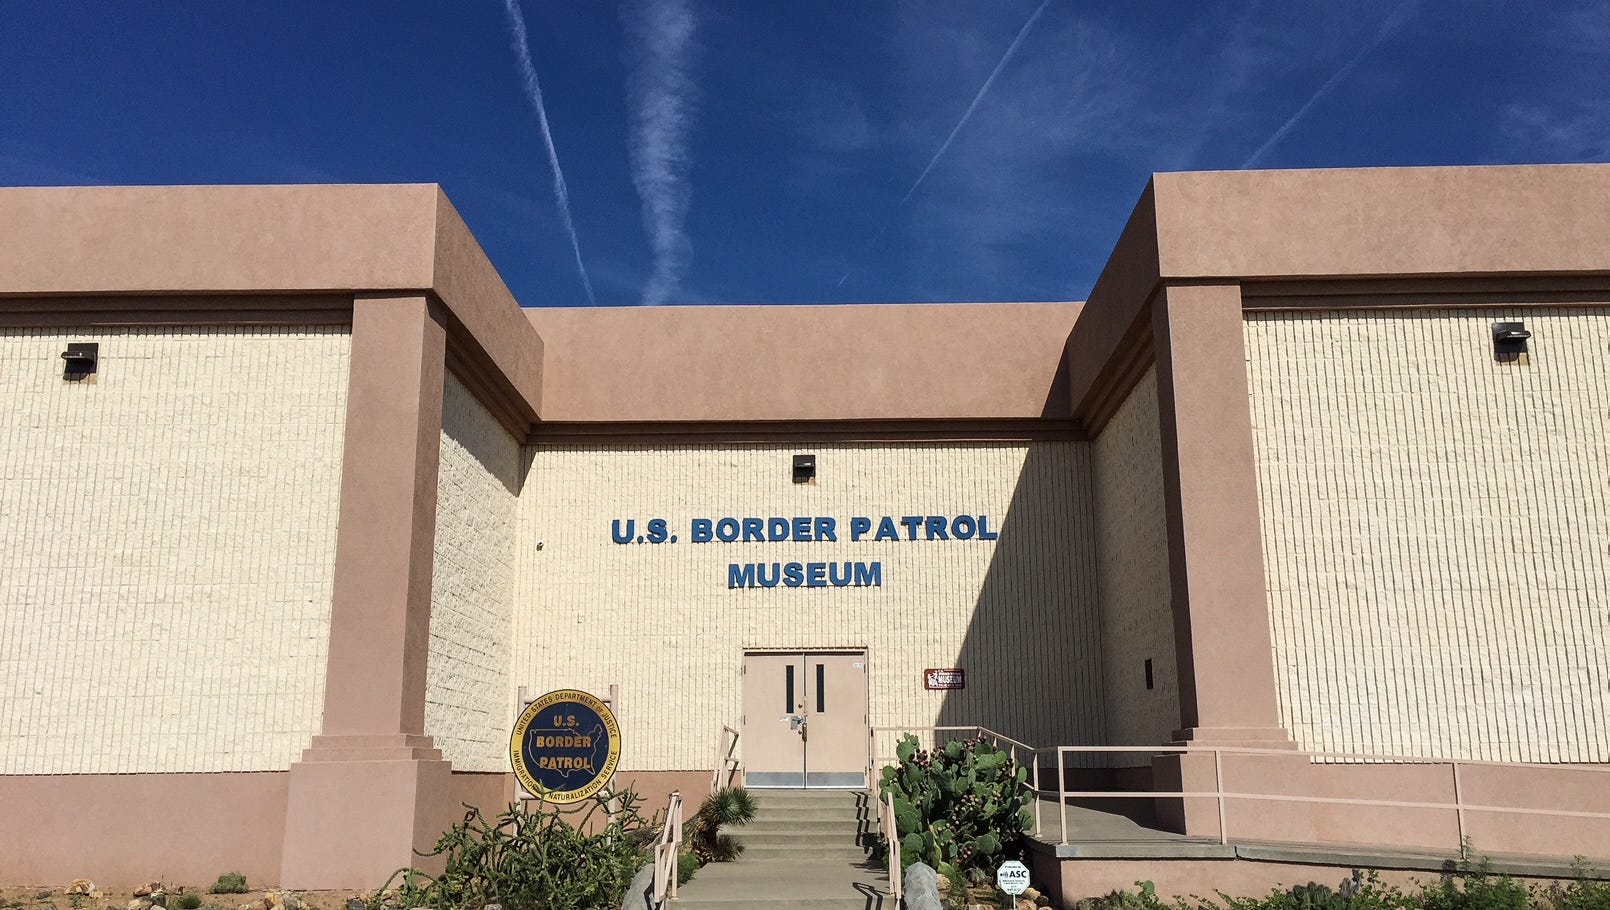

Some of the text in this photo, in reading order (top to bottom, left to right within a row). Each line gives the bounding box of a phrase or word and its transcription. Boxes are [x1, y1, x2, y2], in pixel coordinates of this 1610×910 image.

[611, 515, 998, 544] U.S. BORDER PATROL
[728, 562, 881, 589] MUSEUM
[516, 713, 531, 736] UNITED
[531, 696, 553, 712] STATES
[555, 692, 599, 709] DEPARTMENT
[602, 712, 618, 738] JUSTICE
[553, 715, 580, 727] U.S.
[536, 735, 592, 748] BORDER
[540, 756, 591, 769] PATROL
[548, 779, 602, 801] NATURALIZATION
[601, 751, 618, 779] SERVICE
[1009, 870, 1027, 878] ASC
